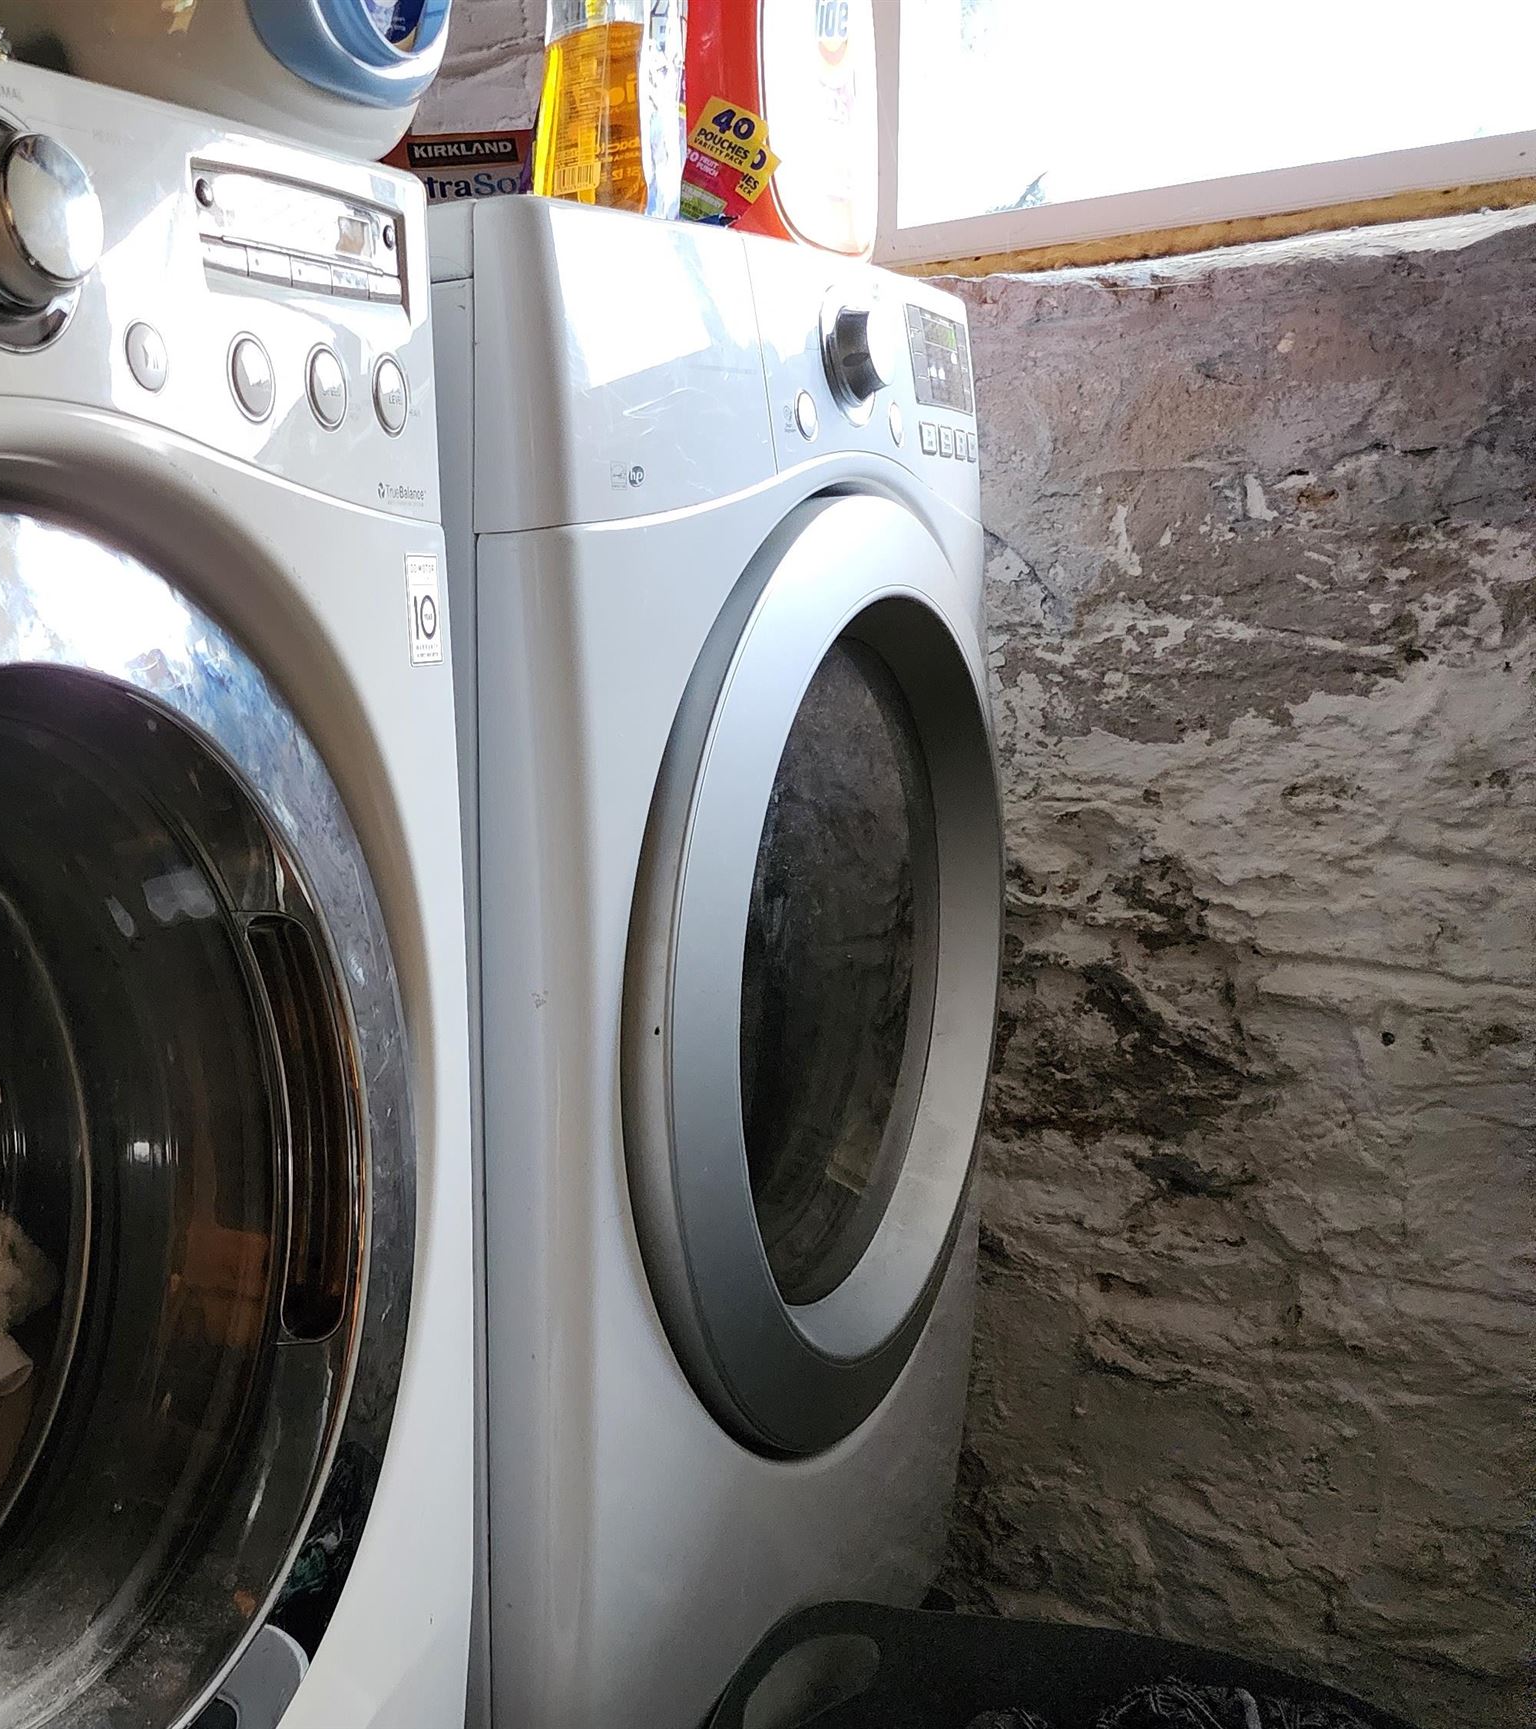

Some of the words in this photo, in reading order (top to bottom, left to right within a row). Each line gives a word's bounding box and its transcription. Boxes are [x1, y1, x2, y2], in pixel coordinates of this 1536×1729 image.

[815, 0, 849, 37] ide
[712, 108, 756, 140] 40
[414, 141, 513, 159] KIRKLAND
[693, 137, 725, 157] VARIETY
[724, 151, 744, 167] PACK
[697, 128, 750, 160] POUCHES
[425, 172, 518, 199] traSo
[413, 594, 437, 640] 10
